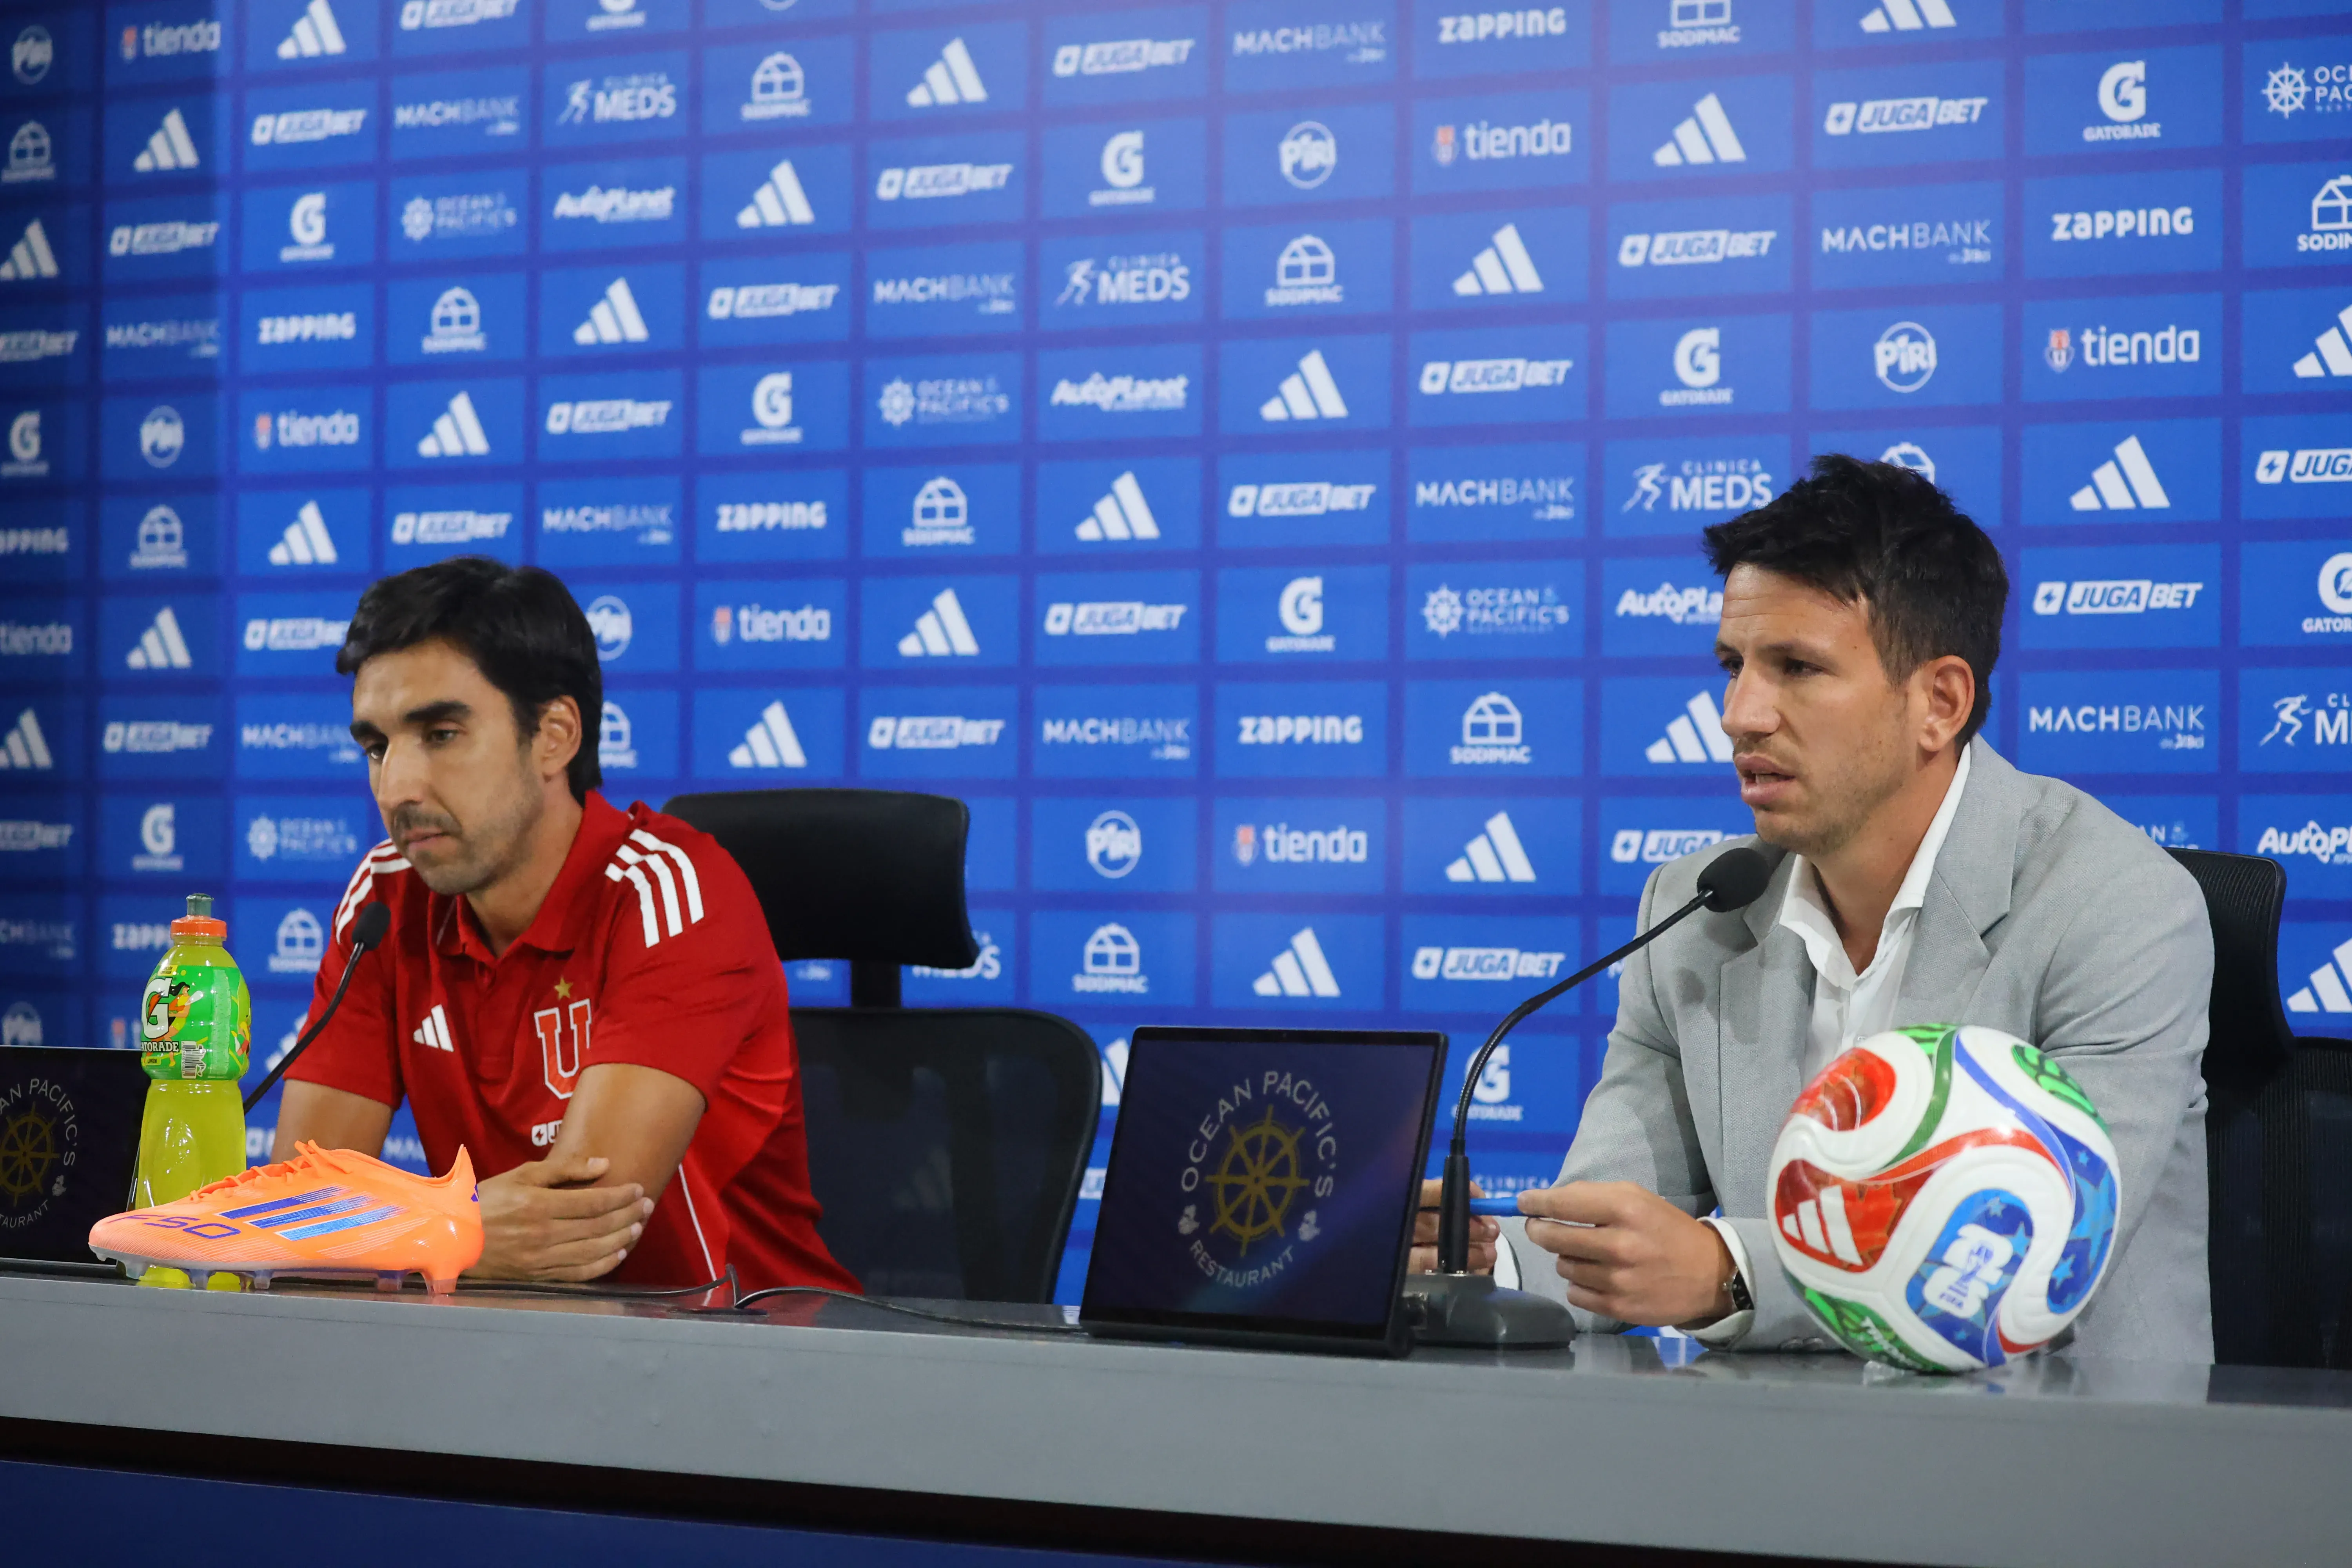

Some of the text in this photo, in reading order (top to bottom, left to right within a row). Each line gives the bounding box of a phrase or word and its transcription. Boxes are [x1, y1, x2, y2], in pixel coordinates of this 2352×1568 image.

[595, 83, 675, 120] MEDS
[2098, 61, 2145, 122] G
[1855, 97, 1987, 132] JUGABET
[2083, 123, 2160, 141] GATORADE
[1465, 120, 1571, 159] tienda
[1102, 132, 1143, 186] G
[291, 194, 325, 242] G
[1822, 221, 1991, 255] MACHBANK
[1098, 266, 1189, 302] MEDS
[1674, 328, 1719, 388] G
[2081, 325, 2199, 365] tienda
[753, 373, 791, 426] G
[277, 412, 359, 446] tienda
[2290, 449, 2352, 483] JUG
[1416, 479, 1572, 508] MACHBANK
[1671, 472, 1772, 509] MEDS
[1280, 577, 1322, 635] G
[1466, 589, 1539, 606] OCEAN
[2067, 580, 2203, 614] JUGABET
[739, 605, 830, 641] tienda
[2029, 706, 2204, 731] MACHBANK
[139, 805, 174, 858] G
[1263, 824, 1367, 862] tienda
[1441, 948, 1565, 980] JUGABET
[142, 977, 173, 1039] G
[141, 1041, 179, 1052] ATORADE
[534, 999, 592, 1099] U
[29, 1078, 77, 1166] PACIFIC'S
[1181, 1071, 1336, 1198] OCEAN PACIFIC'S
[107, 1214, 241, 1240] F50
[1190, 1240, 1294, 1288] RESTAURANT
